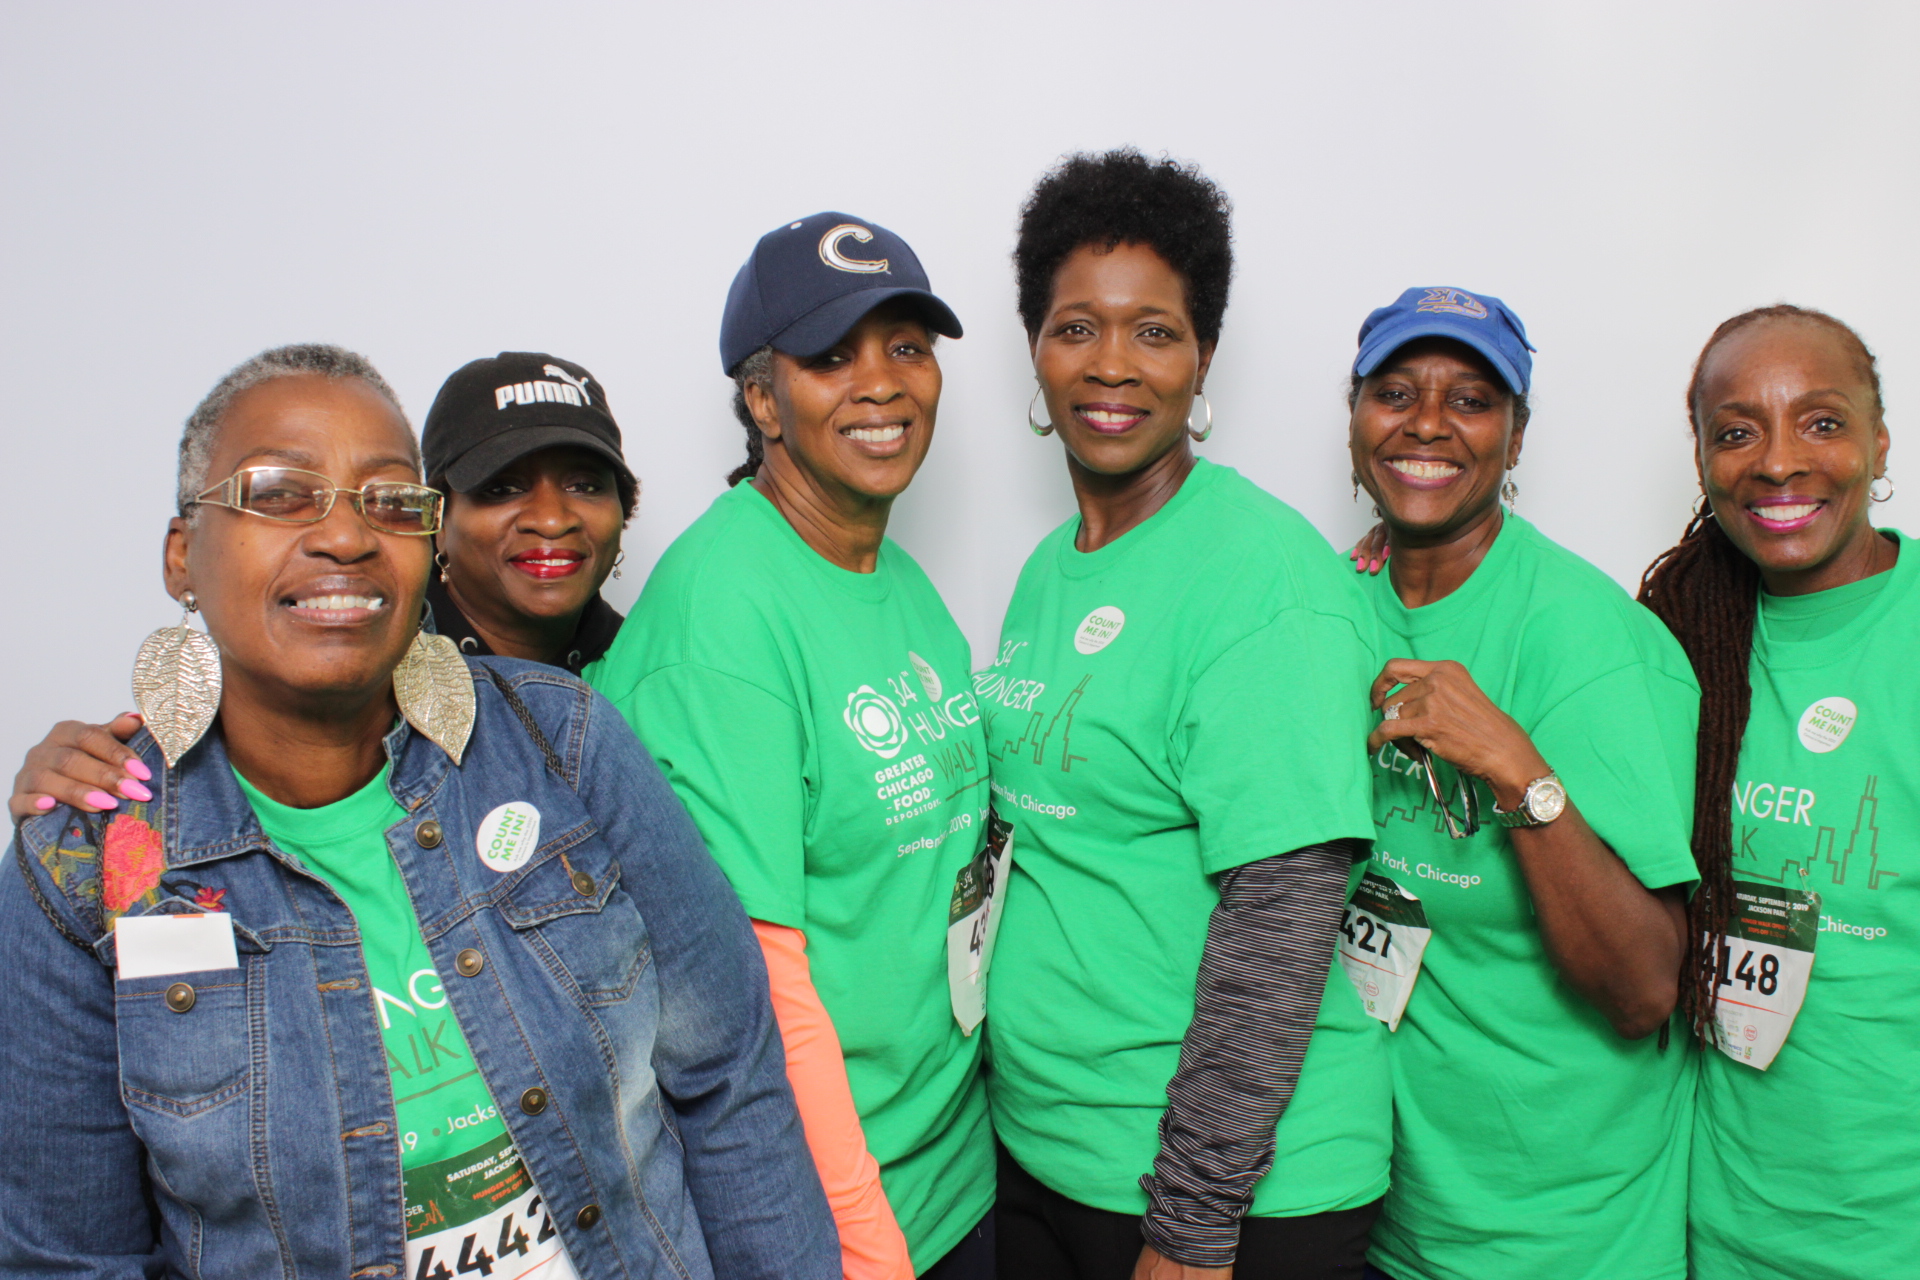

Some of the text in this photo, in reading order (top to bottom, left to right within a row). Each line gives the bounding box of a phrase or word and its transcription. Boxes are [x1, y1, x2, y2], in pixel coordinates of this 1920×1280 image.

[818, 223, 889, 274] C
[494, 380, 582, 410] PUMA
[1083, 626, 1112, 639] ME IN!
[1089, 615, 1121, 630] COUNT
[1808, 716, 1844, 737] ME IN!
[1815, 705, 1853, 726] COUNT
[875, 753, 927, 784] GREATER
[877, 767, 934, 801] CHICAGO
[1020, 794, 1077, 820] Chicago
[487, 807, 517, 860] COUNT
[501, 814, 527, 861] ME IN!
[1382, 850, 1412, 877] Park,
[1416, 863, 1482, 889] Chicago
[1747, 904, 1773, 915] JACKSON
[1792, 902, 1810, 912] 2019
[1817, 914, 1887, 941] Chicago
[446, 1155, 498, 1183] SATURDAY,
[472, 1181, 505, 1201] HUNGER
[490, 1188, 512, 1203] STEPS
[415, 1194, 557, 1280] 4442
